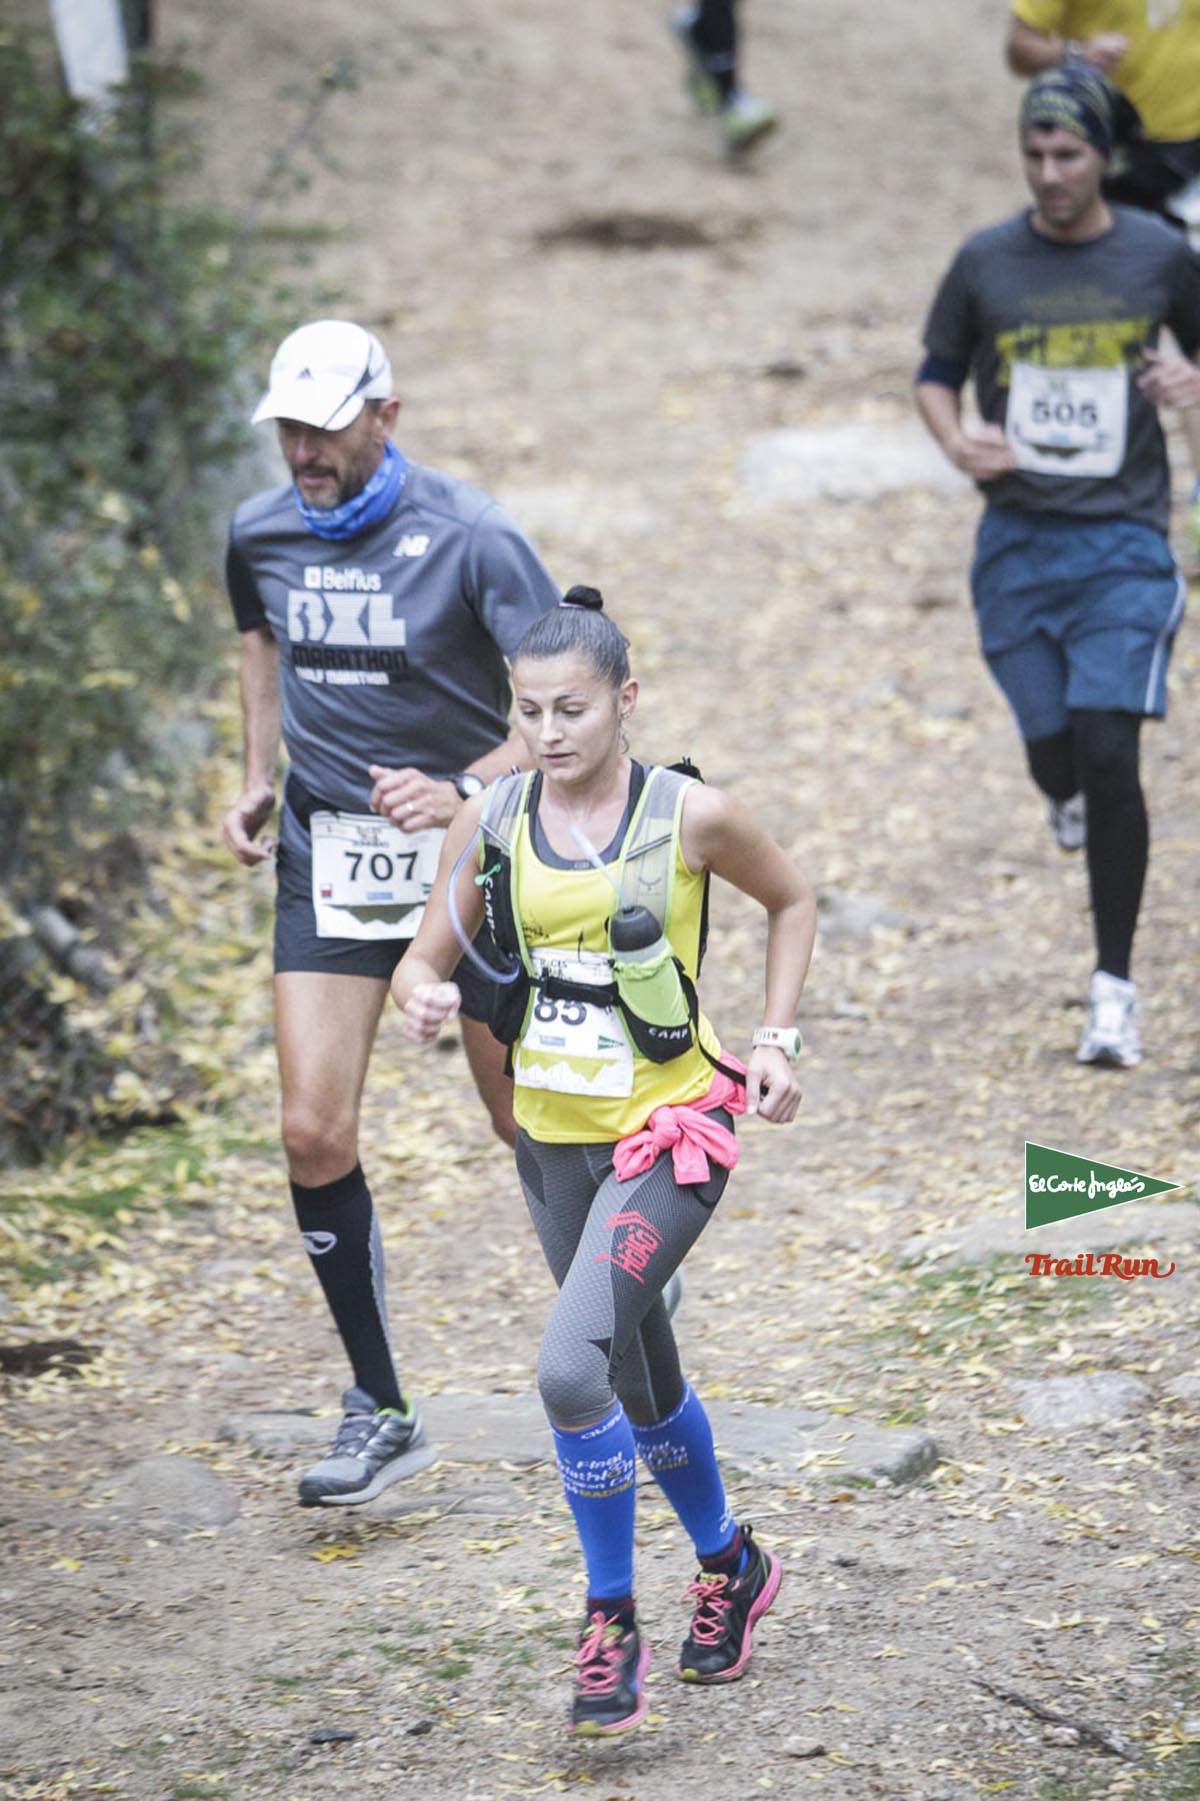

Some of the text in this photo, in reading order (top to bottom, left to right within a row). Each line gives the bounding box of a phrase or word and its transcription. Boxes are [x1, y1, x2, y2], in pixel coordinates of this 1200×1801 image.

[1032, 400, 1098, 427] 505
[323, 567, 381, 591] Belfius
[343, 850, 419, 881] 707
